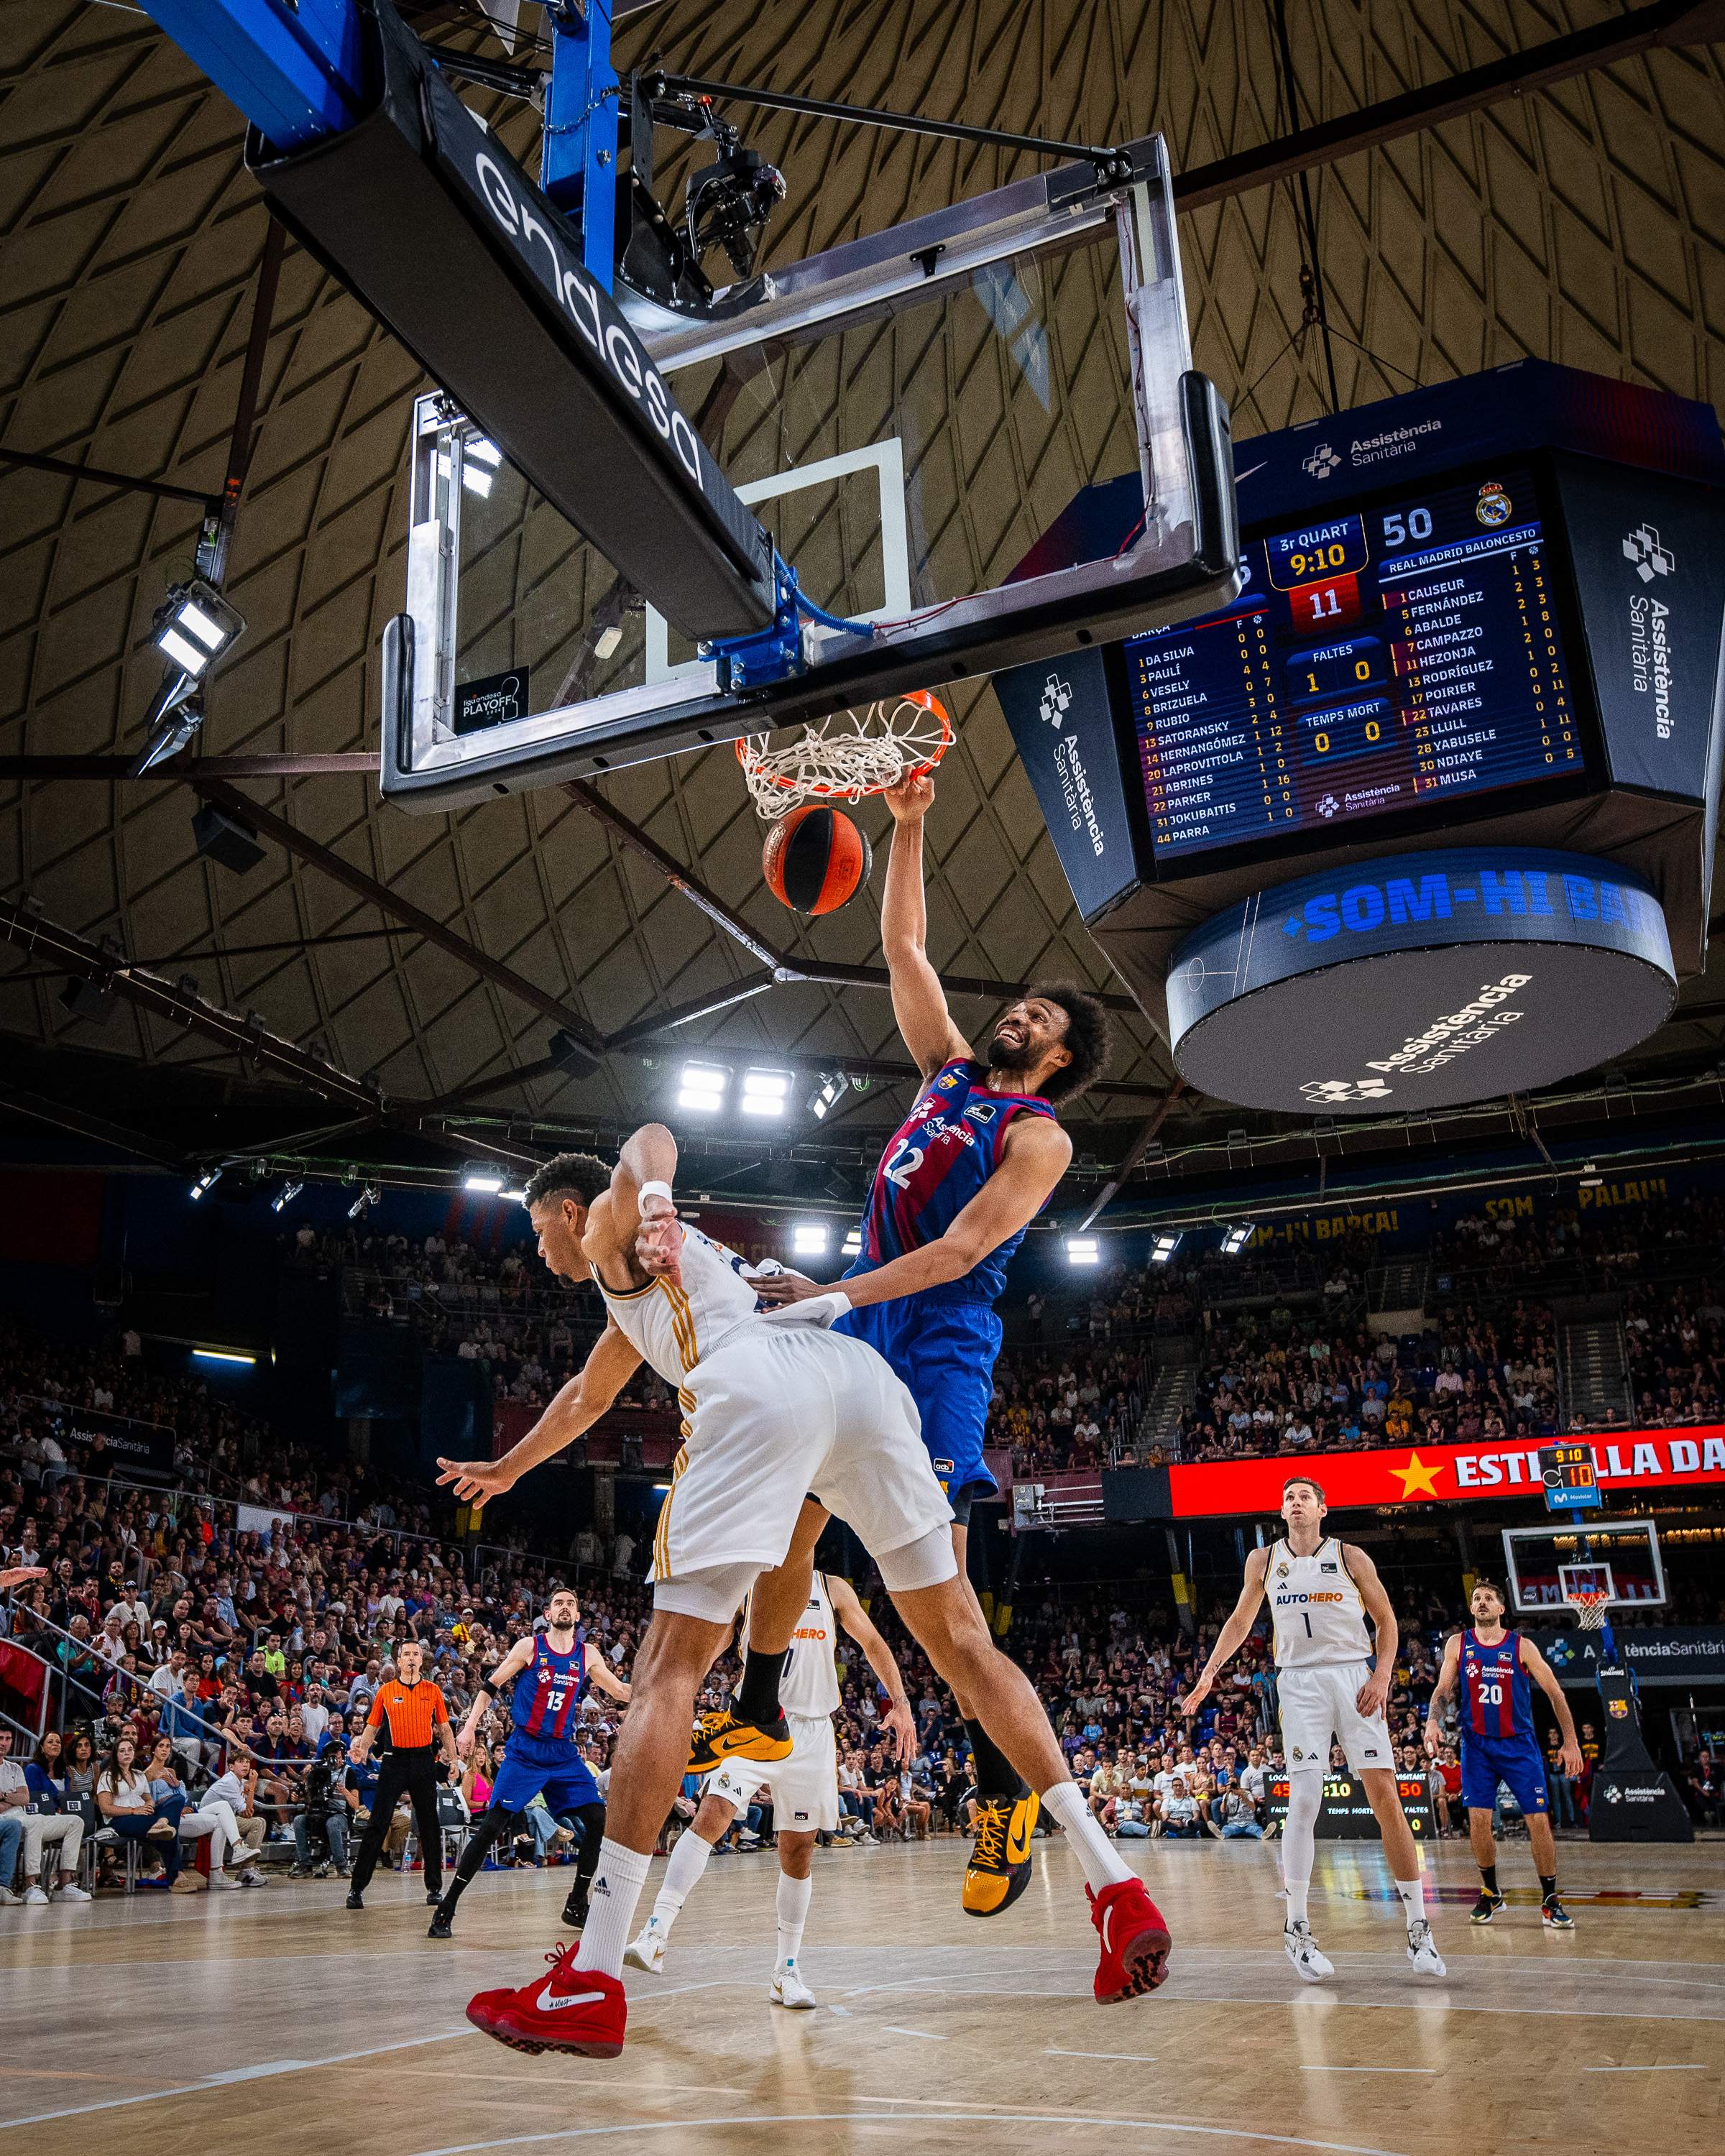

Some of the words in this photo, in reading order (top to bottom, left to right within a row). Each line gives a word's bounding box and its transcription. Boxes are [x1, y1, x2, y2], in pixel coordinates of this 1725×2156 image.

[476, 152, 704, 491] endesa
[1351, 420, 1441, 453] Assistència
[1352, 441, 1416, 466] Sanitària
[1280, 539, 1294, 551] 3r
[1300, 523, 1348, 548] QUART
[1383, 508, 1432, 546] 50
[1290, 544, 1345, 576] 9:10
[1390, 559, 1417, 573] REAL
[1419, 546, 1463, 565] MADRID
[1466, 529, 1535, 553] BALONCESTO
[1511, 552, 1517, 561] F
[1310, 589, 1342, 619] 11
[1401, 594, 1407, 602] 1
[1409, 579, 1464, 601] CAUSEUR
[1402, 610, 1409, 619] 5
[1412, 591, 1484, 617] FERNÁNDEZ
[1515, 582, 1522, 592] 2
[1405, 626, 1412, 635] 6
[1414, 614, 1461, 634] ABALDE
[1518, 599, 1525, 609] 2
[1407, 660, 1418, 671] 11
[1420, 646, 1476, 667] HEZONJA
[1545, 629, 1552, 638] 0
[1408, 643, 1414, 652] 7
[1417, 627, 1483, 650] CAMPAZZO
[1522, 616, 1528, 625] 1
[1630, 595, 1652, 692] Sanitària
[1139, 659, 1144, 668] 1
[1146, 655, 1161, 666] DA
[1163, 646, 1194, 662] SILVA
[1313, 645, 1353, 662] FALTES
[1408, 677, 1420, 688] 13
[1423, 660, 1494, 685] RODRÍGUEZ
[1547, 646, 1555, 655] 0
[1652, 598, 1674, 739] Assistència
[1140, 675, 1146, 683] 3
[1149, 663, 1181, 681] PAULÍ
[1142, 691, 1149, 699] 6
[1151, 680, 1190, 697] VESELY
[1262, 661, 1269, 670] 4
[1307, 673, 1319, 692] 1
[1356, 661, 1370, 680] 0
[1412, 694, 1423, 704] 17
[1425, 682, 1476, 701] POIRIER
[1551, 663, 1559, 673] 2
[464, 695, 512, 717] PLAYOFF
[1144, 706, 1151, 715] 8
[1153, 693, 1207, 713] BRIZUELA
[1306, 711, 1344, 727] TEMPS
[1348, 703, 1380, 718] MORT
[1413, 710, 1426, 721] 22
[1428, 698, 1482, 718] TAVARES
[1552, 679, 1564, 690] 11
[1145, 739, 1156, 748] 13
[1158, 721, 1229, 745] SATORANSKY
[1251, 715, 1258, 724] 2
[1156, 714, 1190, 729] RUBIO
[1415, 727, 1429, 738] 23
[1431, 719, 1466, 734] LLULL
[1557, 697, 1565, 706] 4
[1147, 755, 1159, 765] 14
[1160, 734, 1246, 762] HERNANGÓMEZ
[1255, 731, 1260, 740] 1
[1270, 726, 1282, 737] 12
[1315, 733, 1330, 752] 0
[1366, 722, 1380, 741] 0
[1417, 745, 1431, 755] 28
[1433, 729, 1496, 752] YABUSELE
[1559, 714, 1570, 725] 11
[1148, 770, 1161, 780] 20
[1163, 751, 1243, 777] LAPROVITTOLA
[1420, 761, 1435, 772] 30
[1438, 750, 1483, 768] NDIAYE
[1542, 736, 1550, 745] 0
[1425, 778, 1438, 788] 31
[1440, 770, 1476, 786] MUSA
[1545, 753, 1552, 763] 0
[1054, 743, 1081, 831] Sanitària
[1065, 734, 1104, 857] Assistència
[1152, 786, 1163, 796] 21
[1166, 775, 1213, 793] ABRINES
[1260, 763, 1265, 772] 1
[1153, 802, 1166, 812] 22
[1168, 792, 1210, 809] PARKER
[1262, 780, 1268, 788] 1
[1278, 775, 1289, 786] 16
[1345, 784, 1400, 802] Assistència
[1157, 818, 1167, 827] 31
[1170, 803, 1236, 825] JOKUBAITIS
[1283, 791, 1290, 801] 0
[1346, 798, 1385, 811] Sanitària
[1157, 834, 1171, 844] 44
[1173, 826, 1210, 841] PARRA
[1286, 808, 1292, 817] 0
[1303, 871, 1554, 944] SOM-HI
[1366, 974, 1532, 1072] Assistència
[1399, 1011, 1524, 1073] Sanitària
[883, 1138, 924, 1189] 22
[1485, 1195, 1534, 1220] SOM
[1570, 1465, 1592, 1486] 10
[1276, 1593, 1343, 1606] AUTOHERO
[1300, 1613, 1312, 1638] 1
[547, 1691, 566, 1710] 13
[1478, 1684, 1502, 1705] 20
[1272, 1783, 1289, 1797] 45
[1324, 1783, 1350, 1797] :10
[1400, 1783, 1422, 1796] 50
[1412, 1819, 1420, 1830] 0
